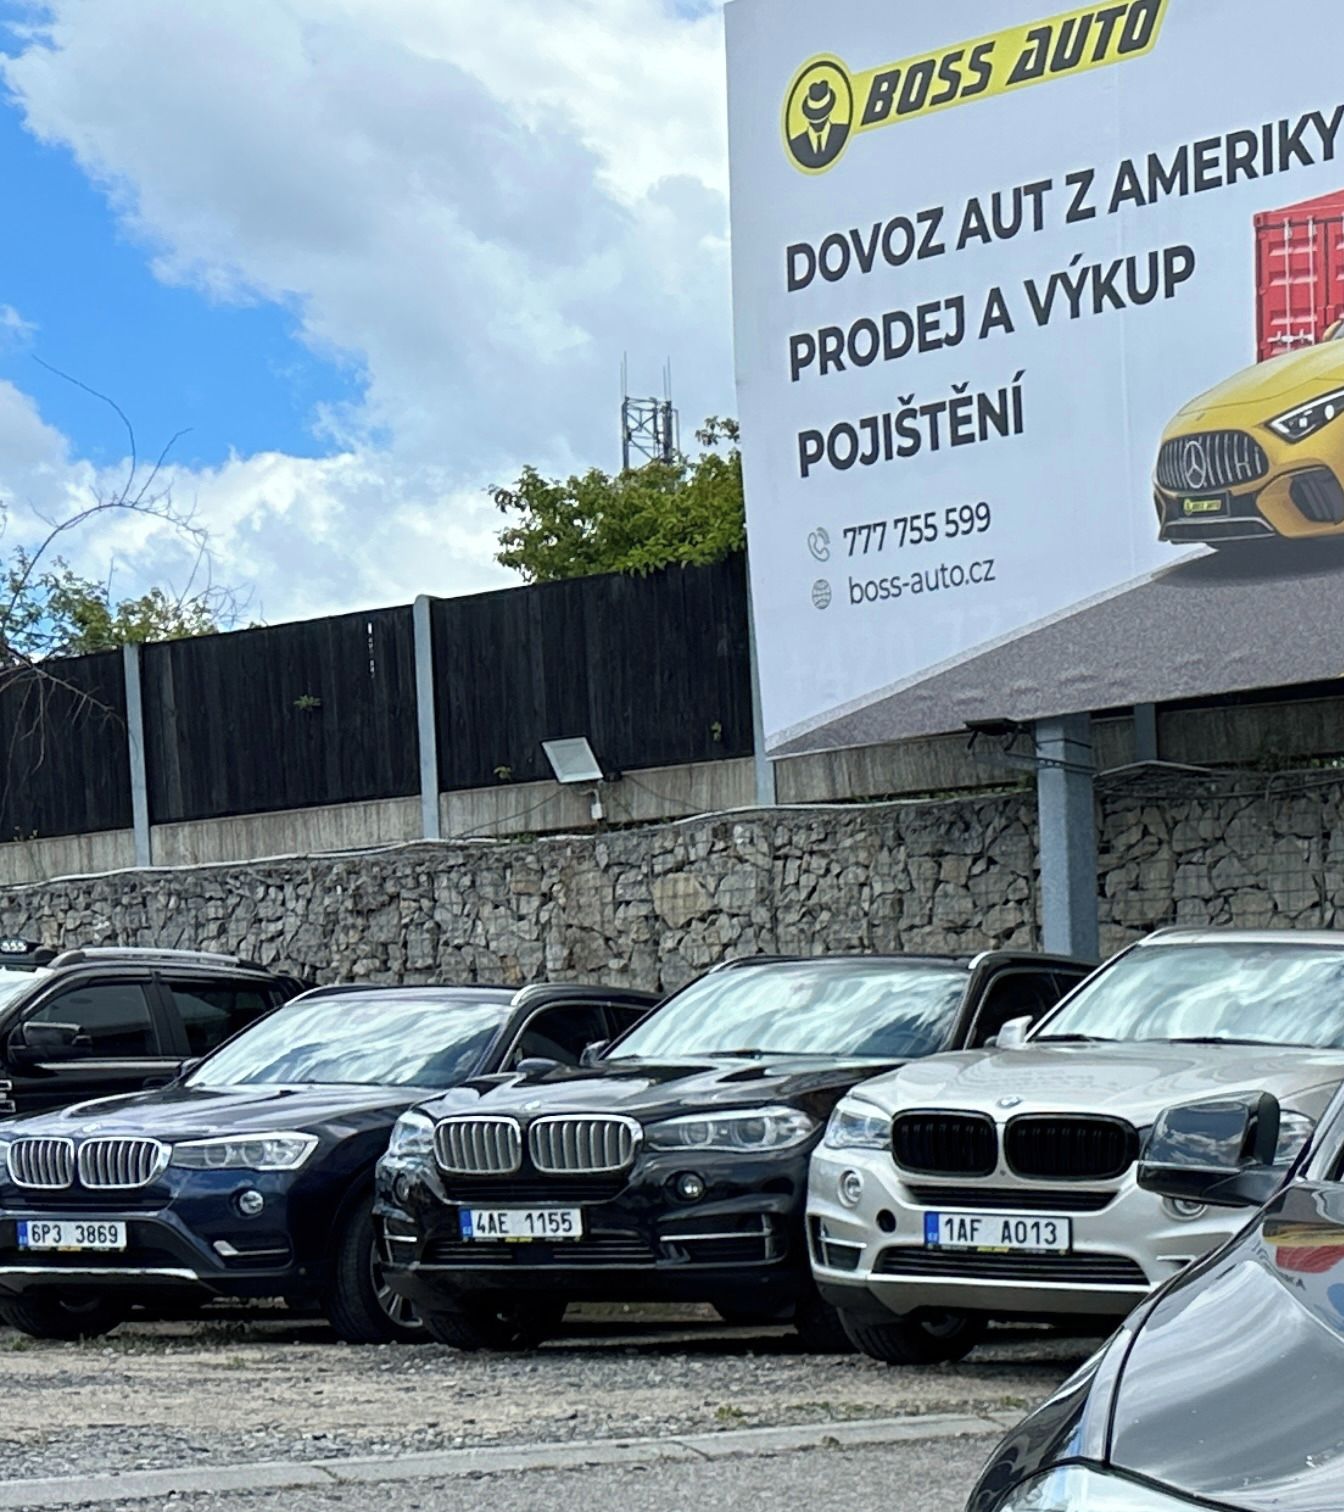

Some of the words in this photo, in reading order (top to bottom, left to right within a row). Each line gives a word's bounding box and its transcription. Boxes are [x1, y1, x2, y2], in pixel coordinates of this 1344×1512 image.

[861, 41, 996, 126] BOSS
[1005, 0, 1161, 86] AUTO
[786, 207, 945, 292] DOVOZ
[956, 179, 1053, 251] AUT
[1066, 168, 1095, 224] Z
[789, 296, 965, 383] PRODEJ
[978, 287, 1015, 340] A
[1024, 245, 1196, 327] VÝKUP
[798, 369, 1026, 479] POJIŠTĚNÍ
[843, 521, 887, 557] 777
[894, 512, 939, 548] 755
[945, 502, 992, 539] 599
[848, 558, 996, 605] boss-auto.cz
[31, 1224, 62, 1243] 6P3
[75, 1224, 118, 1243] 3869
[476, 1212, 509, 1234] 4AE
[525, 1212, 572, 1234] 1155
[944, 1218, 982, 1242] 1AF
[1000, 1220, 1057, 1245] A013
